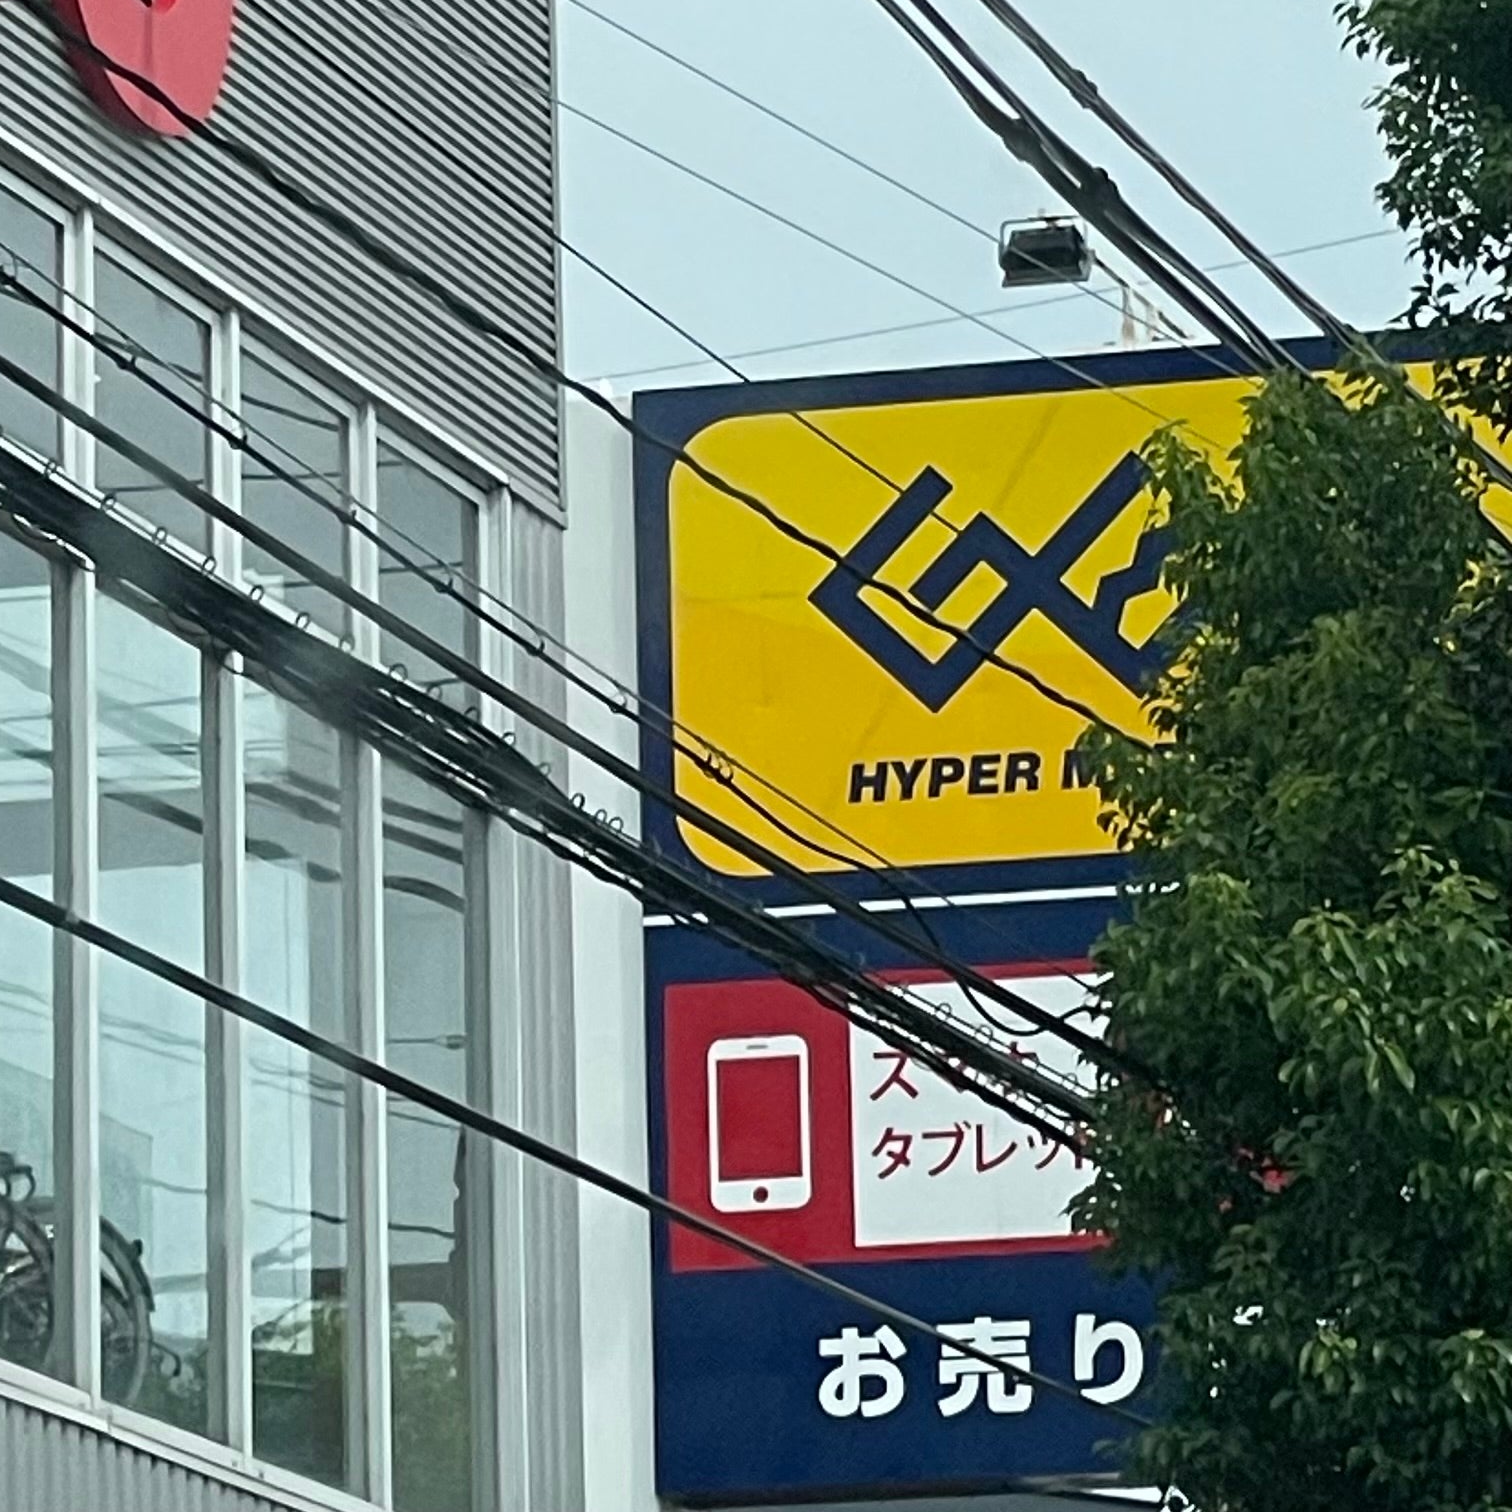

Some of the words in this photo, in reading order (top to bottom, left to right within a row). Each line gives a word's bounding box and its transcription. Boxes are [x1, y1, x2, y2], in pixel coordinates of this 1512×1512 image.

[848, 751, 1041, 803] HYPER
[817, 1313, 1145, 1419] お売り
